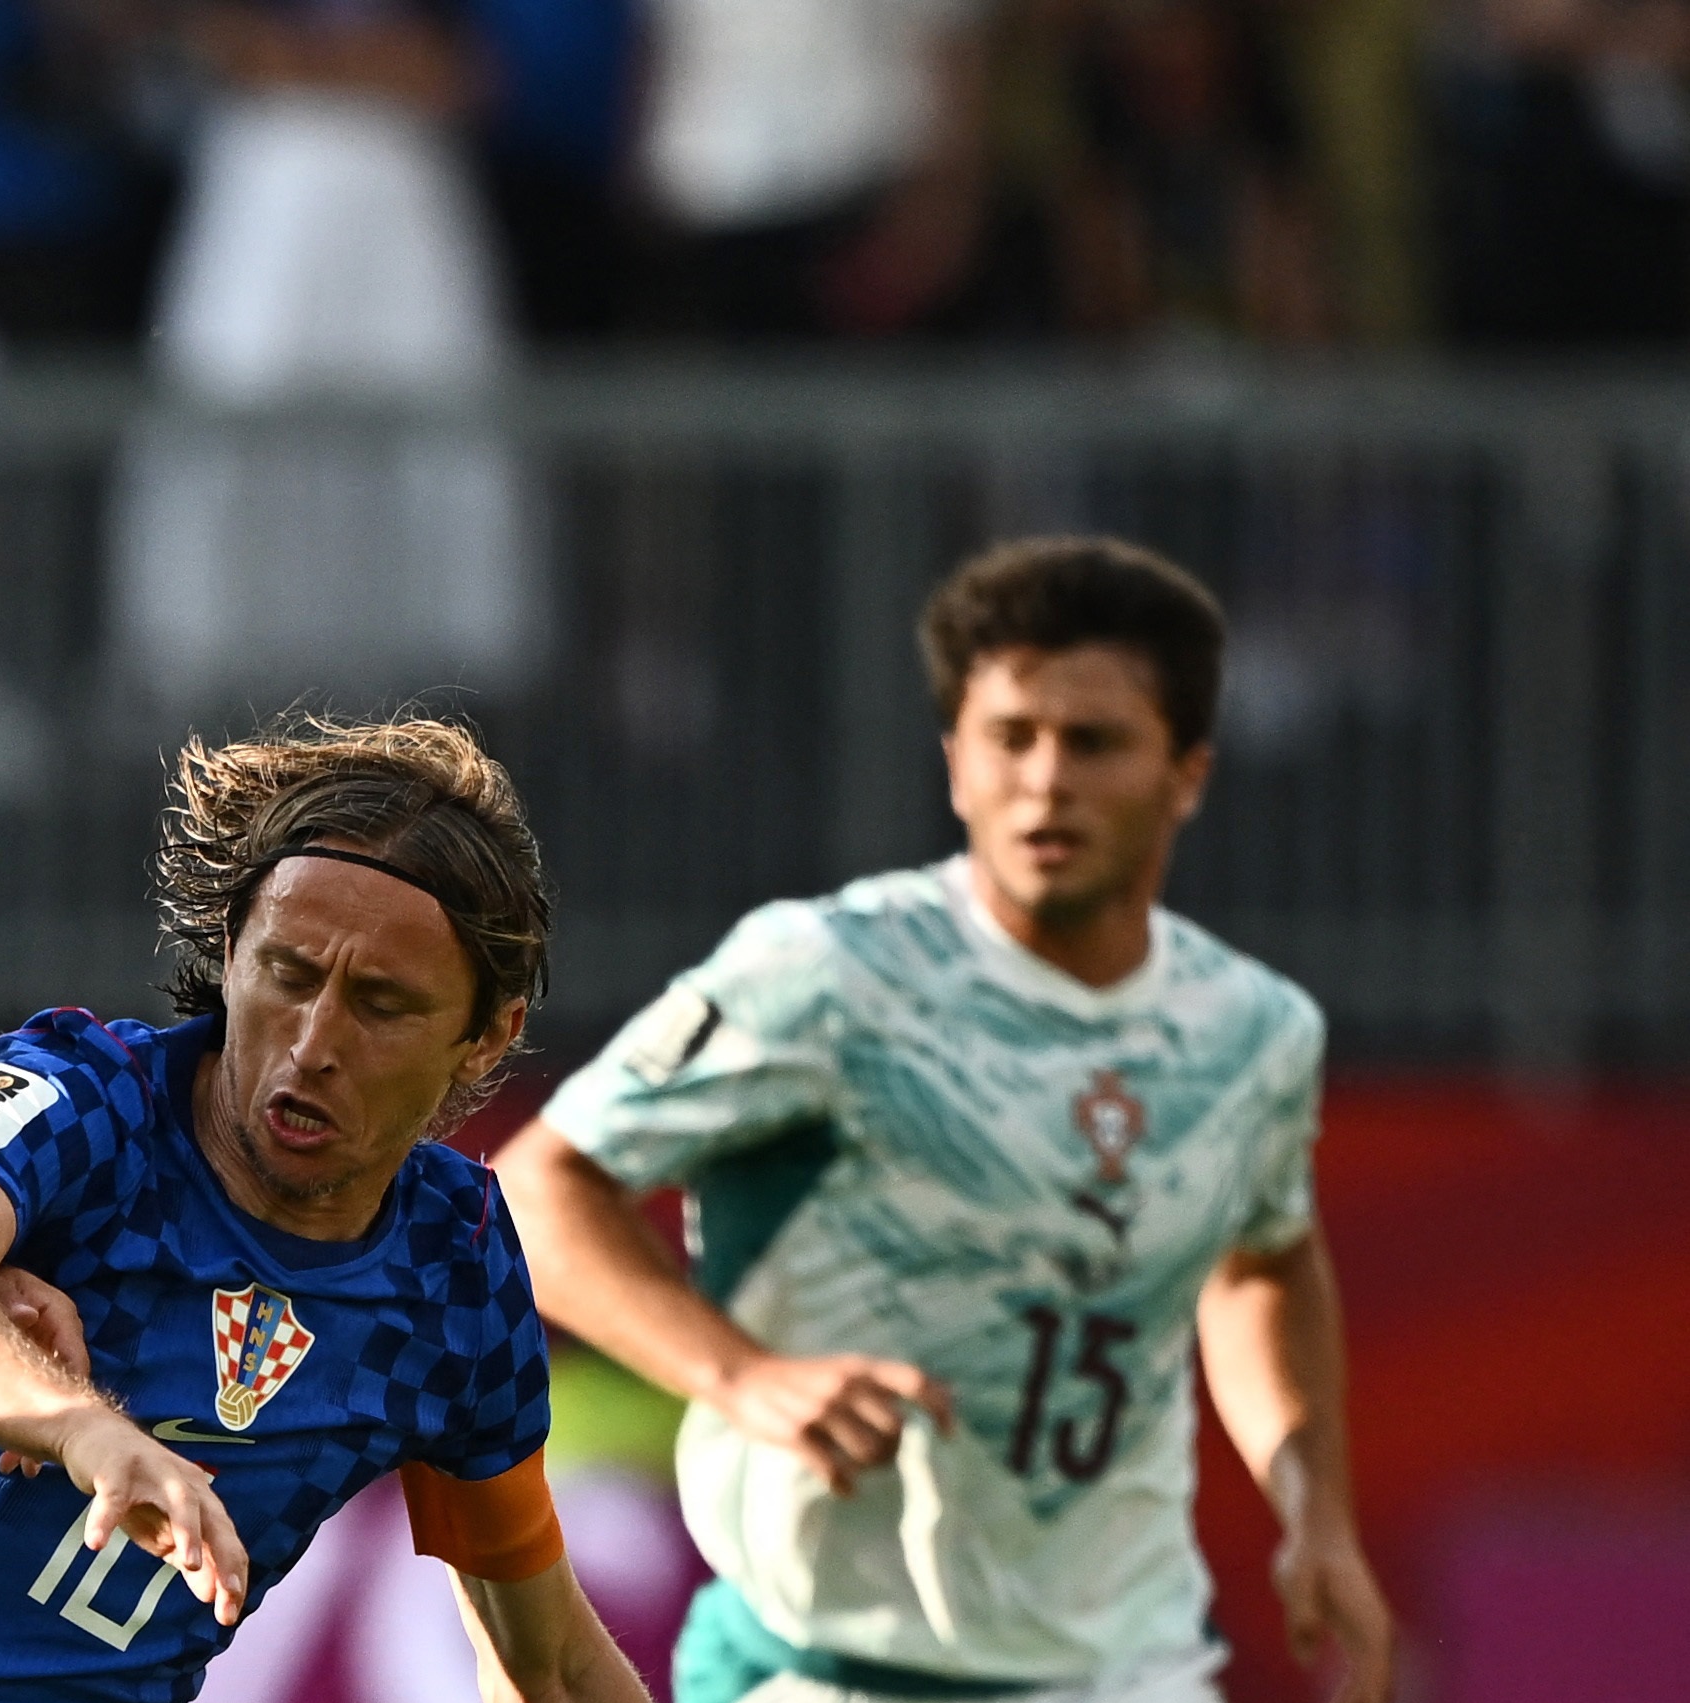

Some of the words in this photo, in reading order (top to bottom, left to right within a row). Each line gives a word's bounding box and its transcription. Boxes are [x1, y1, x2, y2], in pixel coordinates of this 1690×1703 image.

[242, 1302, 274, 1372] HNS
[1007, 1304, 1139, 1482] 15
[27, 1492, 180, 1652] 10
